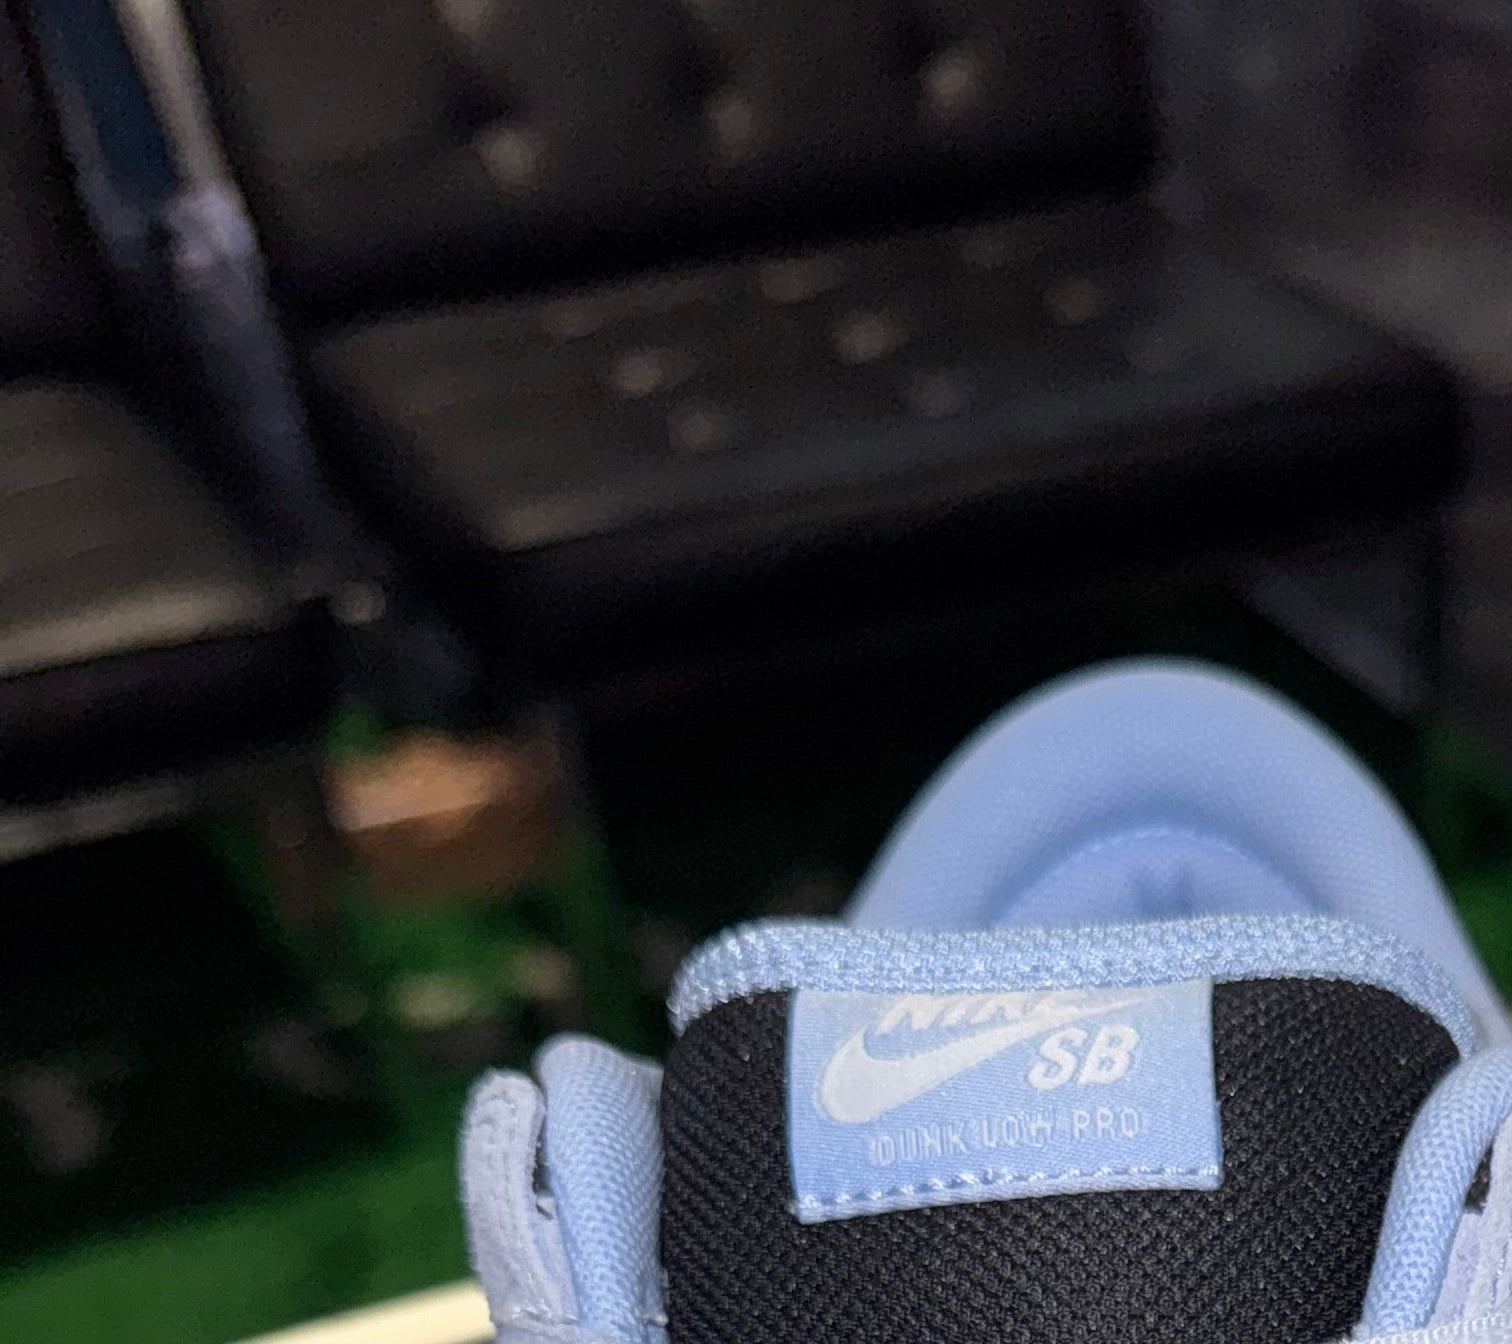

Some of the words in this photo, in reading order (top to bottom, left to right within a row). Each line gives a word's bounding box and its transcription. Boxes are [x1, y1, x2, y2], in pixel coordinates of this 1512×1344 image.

[1027, 1024, 1140, 1091] SB
[872, 1122, 968, 1165] DUNK
[982, 1109, 1055, 1148] LOW
[1071, 1107, 1139, 1141] PRO
